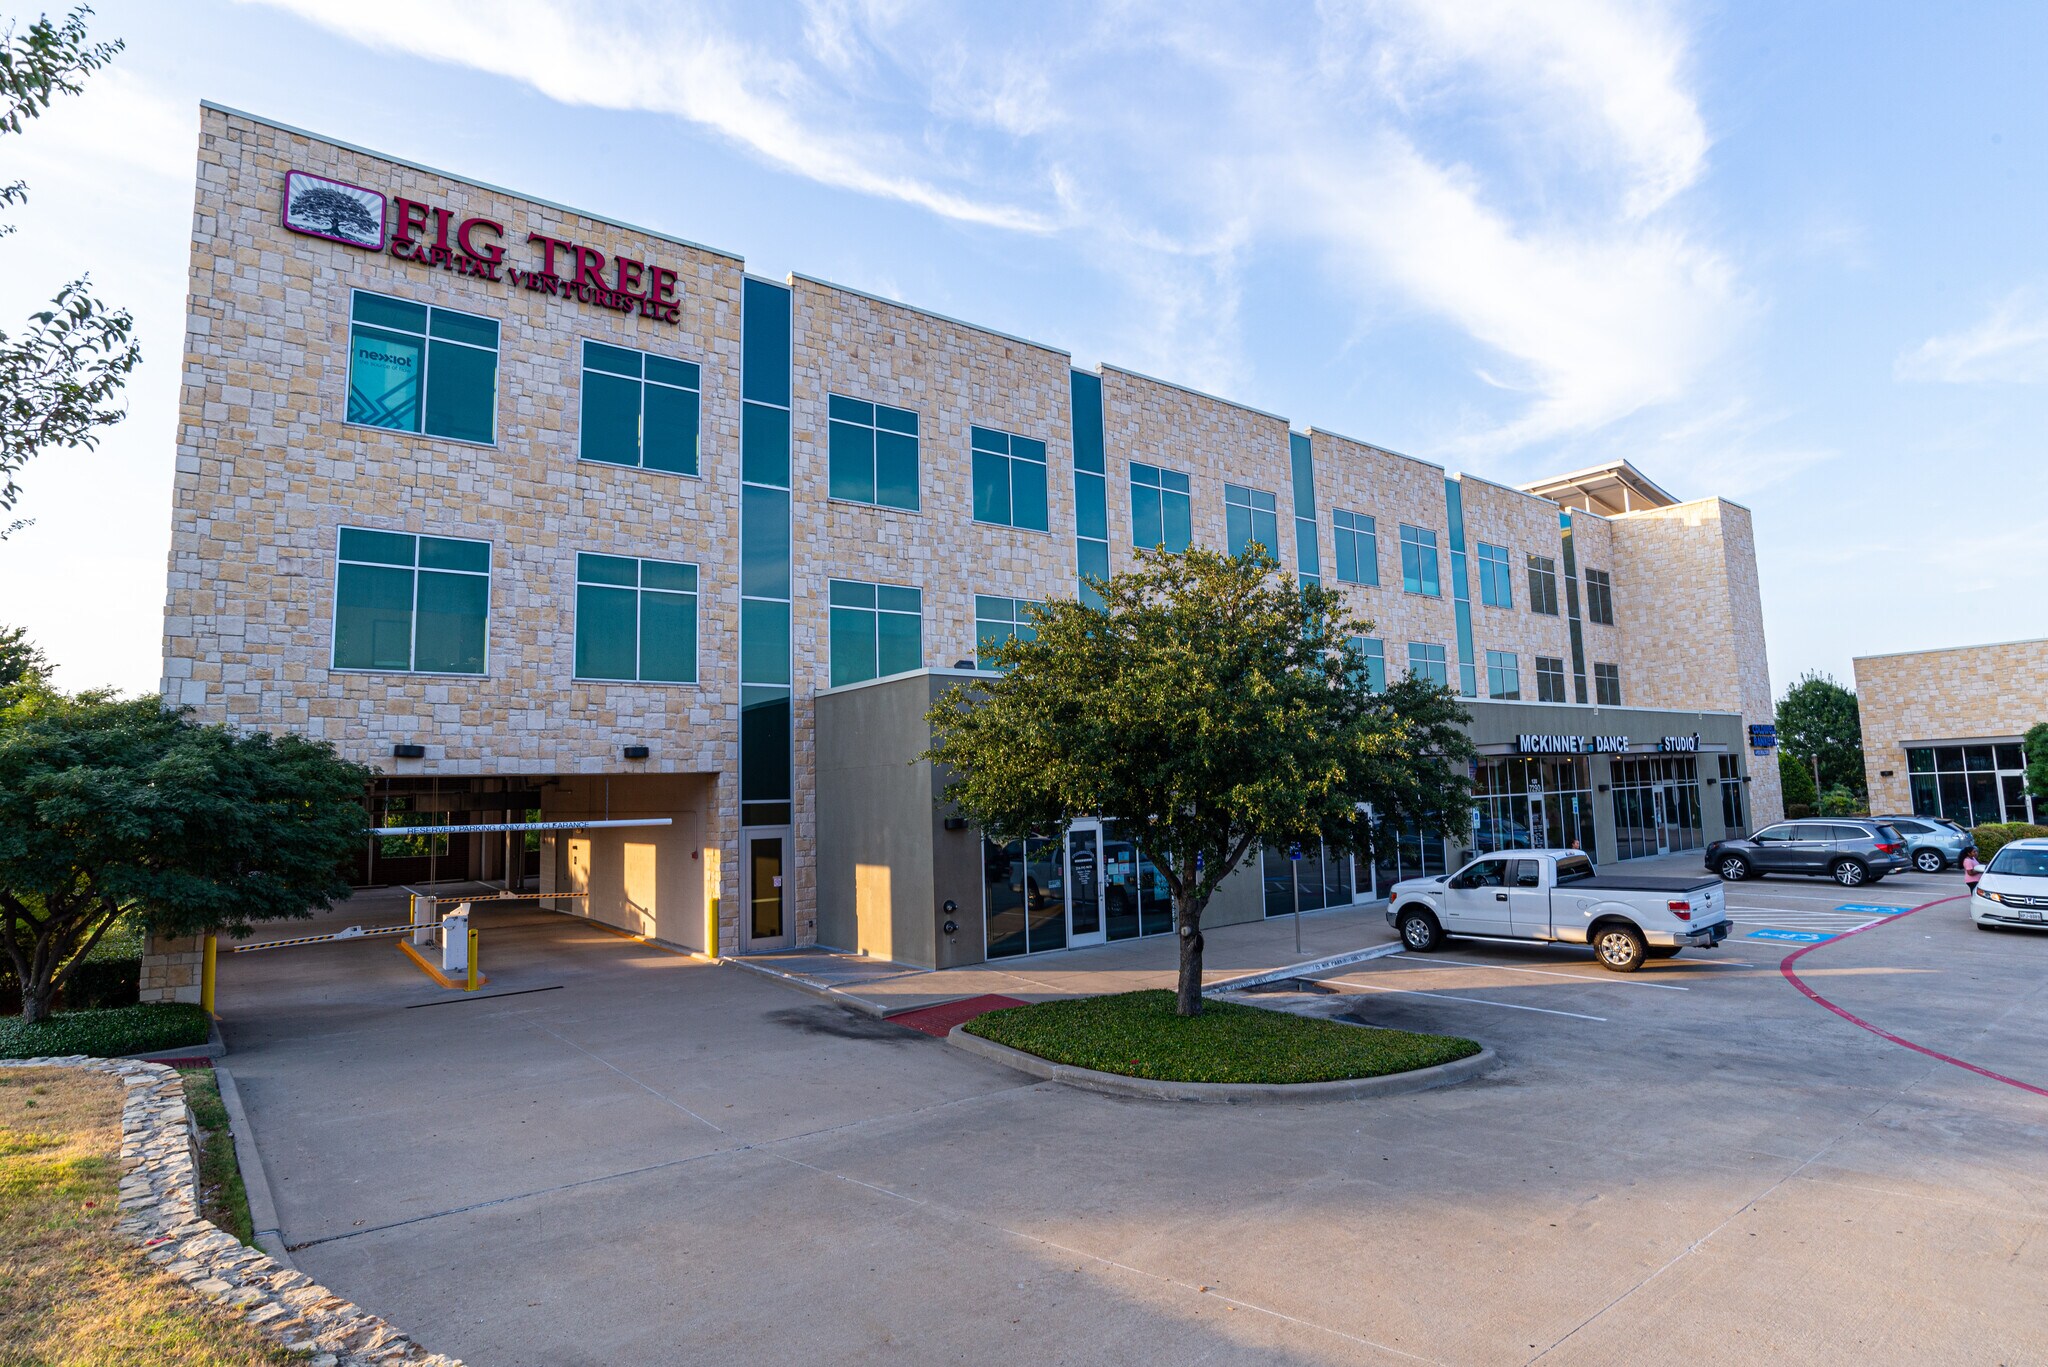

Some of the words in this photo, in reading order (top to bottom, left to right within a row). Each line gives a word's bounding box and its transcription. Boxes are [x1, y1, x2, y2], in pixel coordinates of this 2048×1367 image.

[391, 196, 506, 265] FIG
[527, 231, 681, 309] TREE
[391, 240, 502, 282] CAPITAL
[508, 267, 634, 313] VENTURES
[639, 300, 681, 325] LLC
[1520, 734, 1585, 753] MCKINNEY
[1596, 735, 1629, 752] DANCE
[1664, 736, 1694, 752] STUDIO
[407, 826, 456, 835] RESERVED
[458, 825, 496, 833] PARKING
[499, 823, 521, 831] ONLY
[542, 822, 589, 830] CLEARANCE
